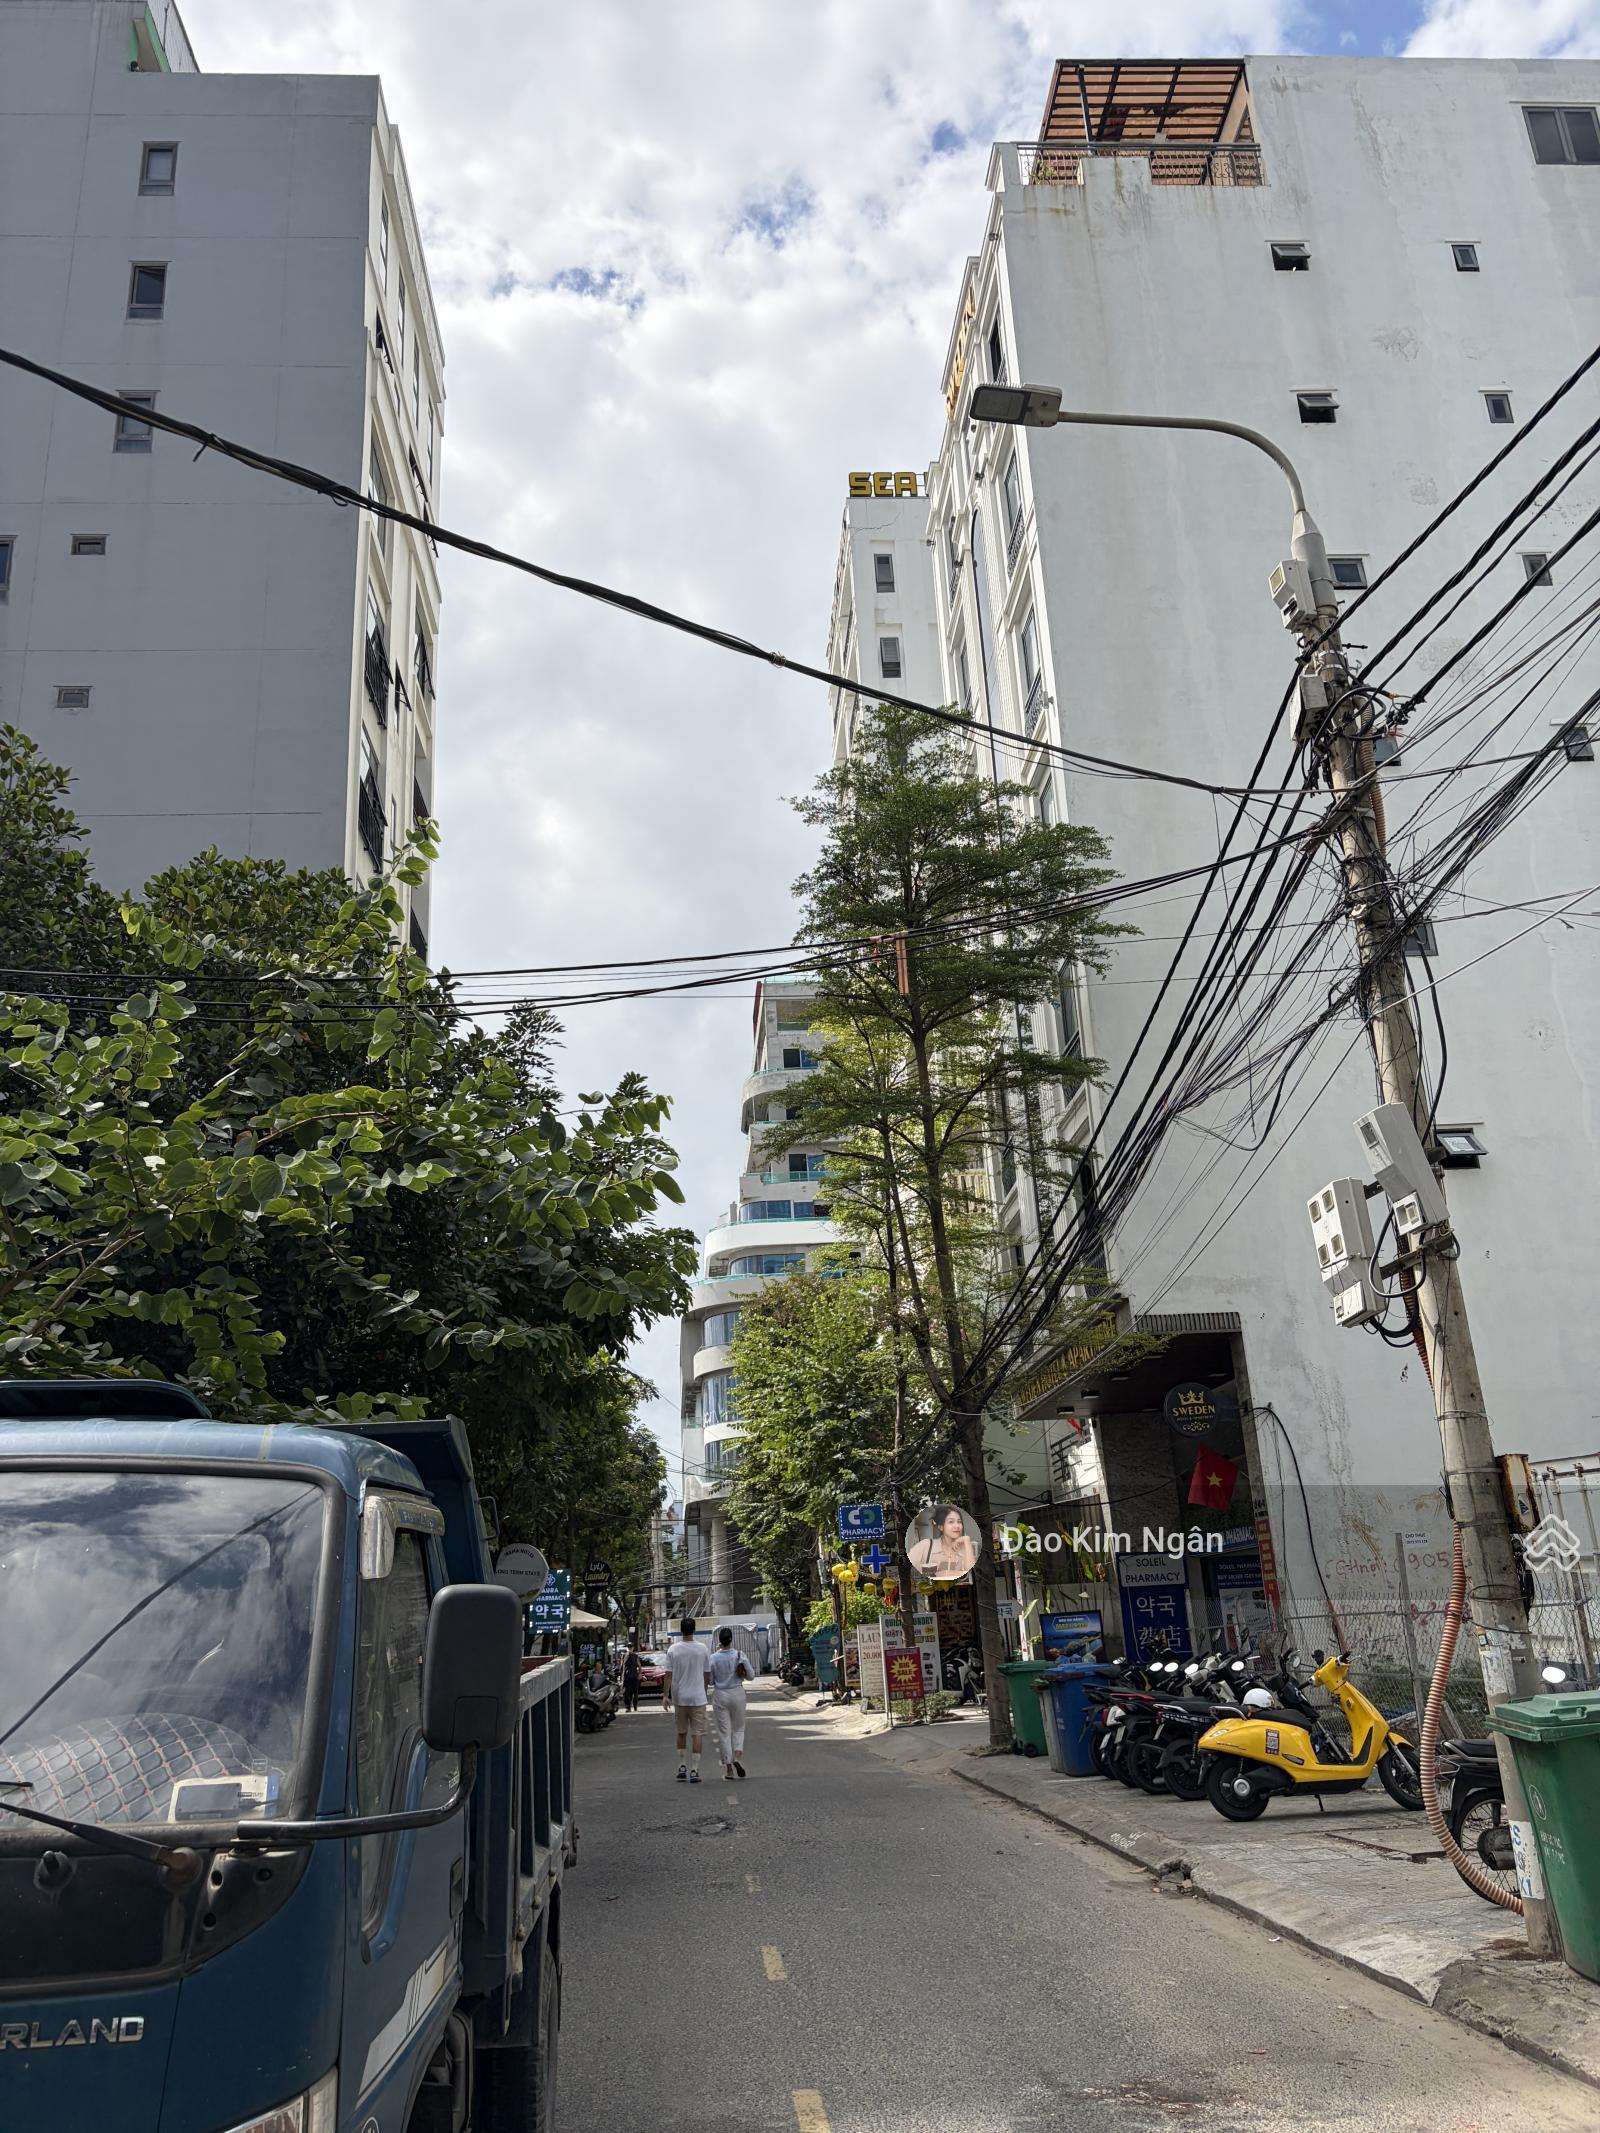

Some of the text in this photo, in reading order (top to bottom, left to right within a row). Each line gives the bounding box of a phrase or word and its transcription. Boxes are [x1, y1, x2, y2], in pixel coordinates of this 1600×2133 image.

[849, 472, 918, 497] SEA
[1172, 1404, 1216, 1417] SWEDEN
[841, 1527, 883, 1536] PHARMACY
[1136, 1557, 1166, 1568] SOLEIL
[1125, 1572, 1181, 1583] PHARMACY
[535, 1604, 565, 1620] 약국
[1136, 1595, 1176, 1618] 약국
[897, 1668, 913, 1676] SALE
